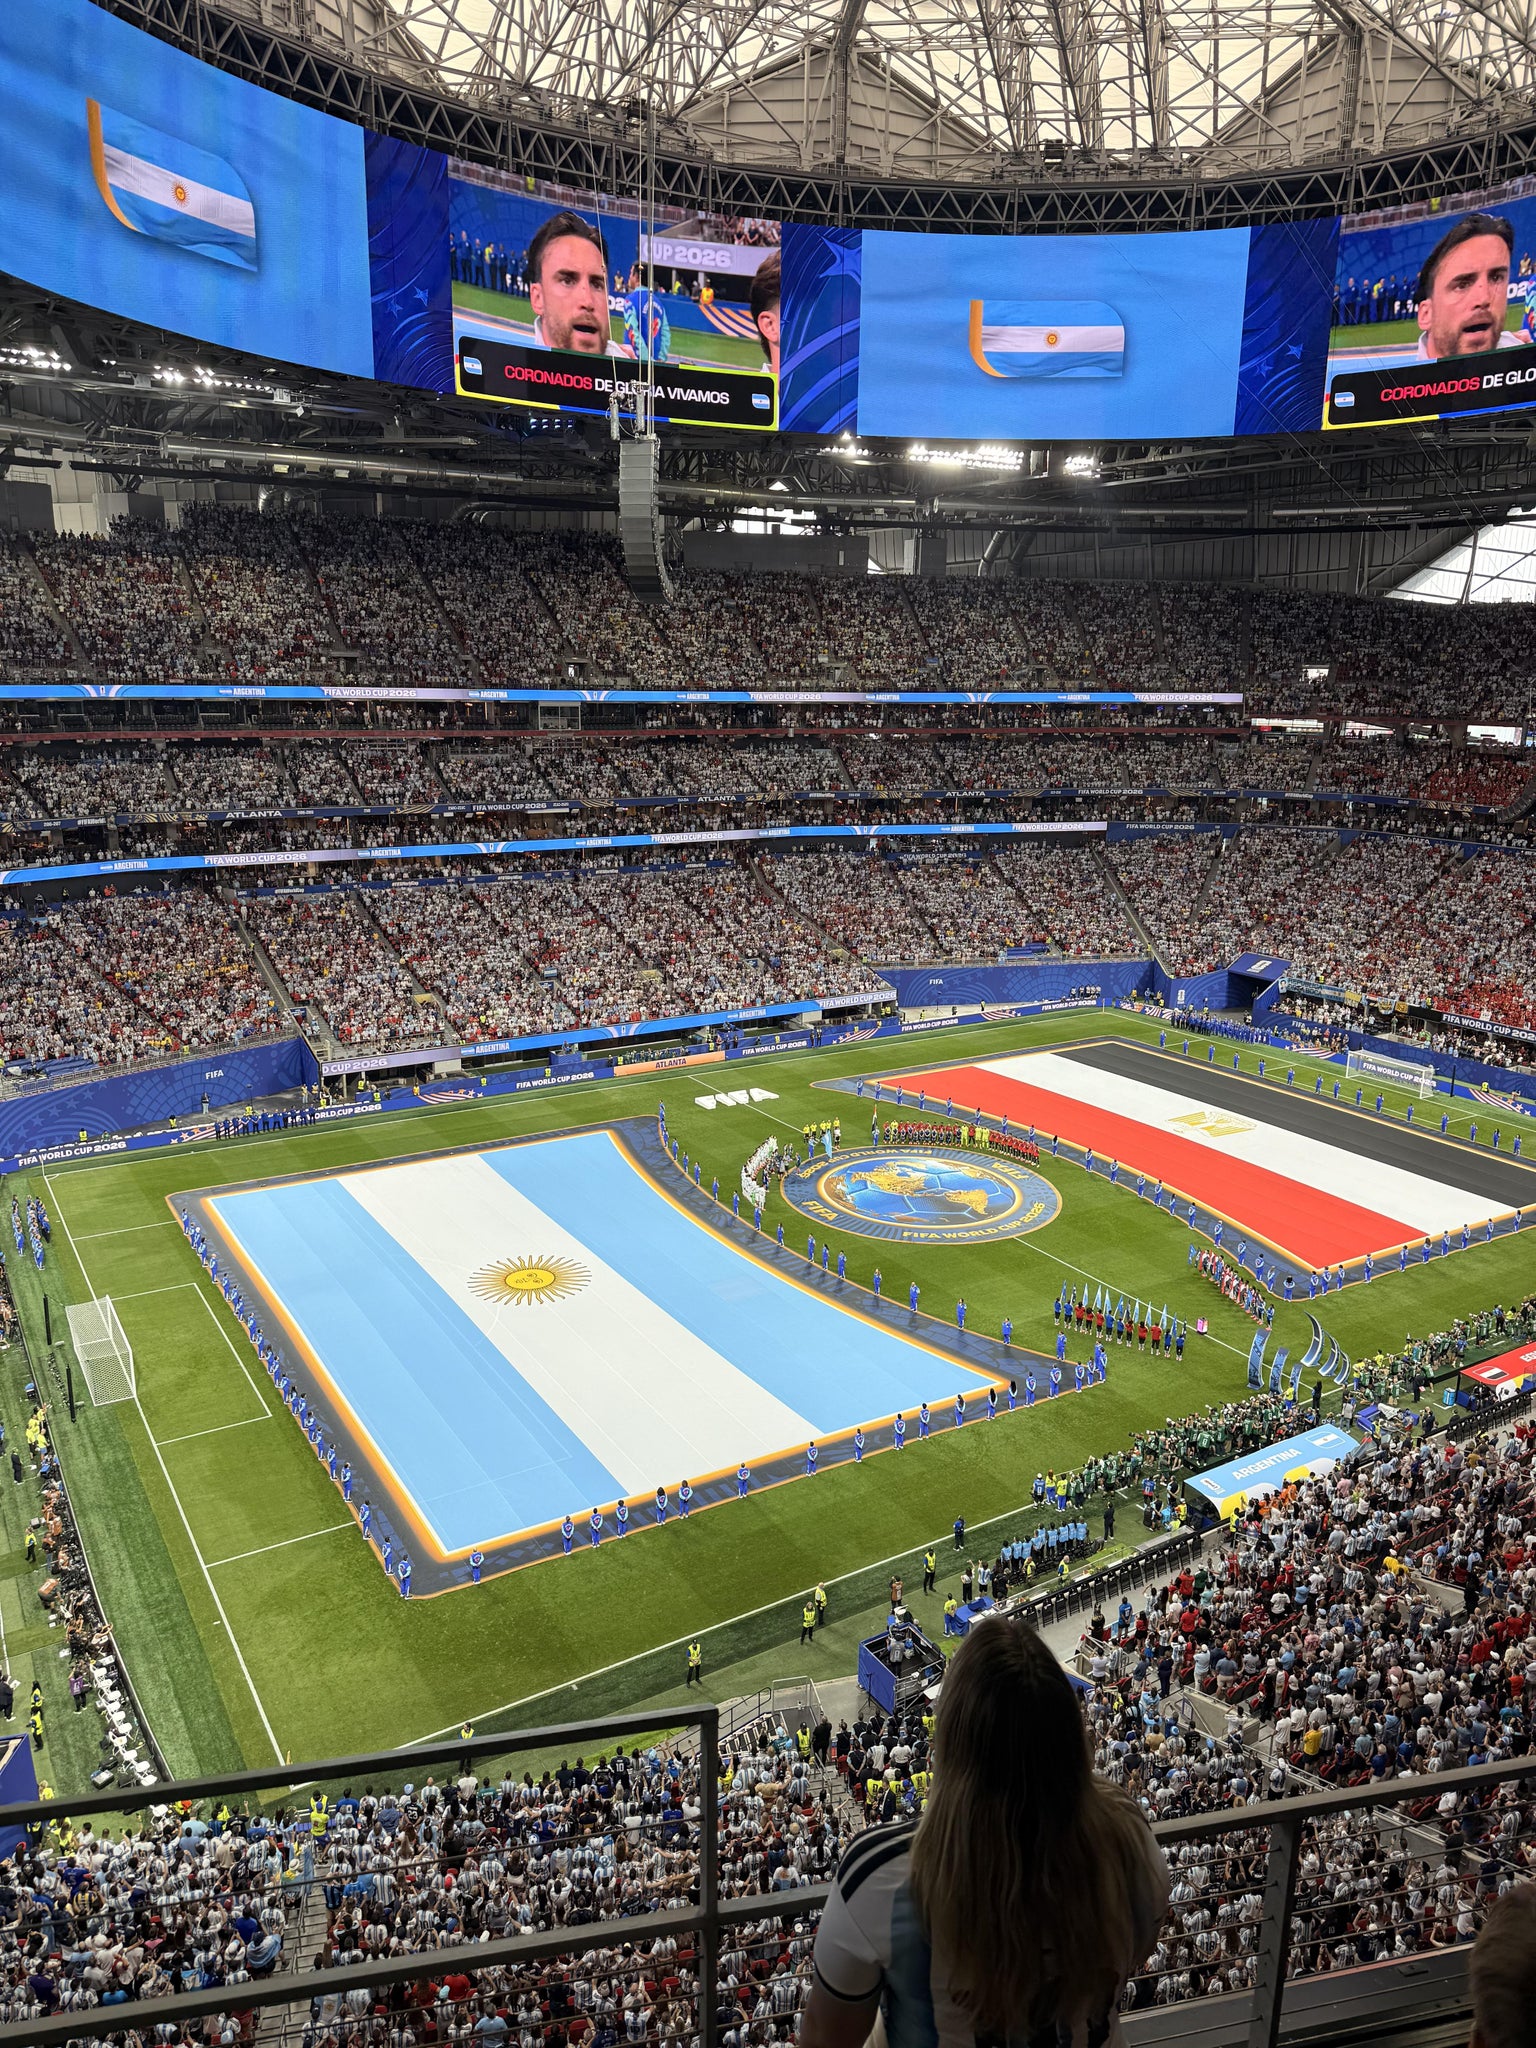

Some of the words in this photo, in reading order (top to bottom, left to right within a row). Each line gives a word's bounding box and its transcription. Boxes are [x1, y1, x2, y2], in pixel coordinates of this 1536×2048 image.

[674, 245, 732, 268] 2026
[504, 365, 593, 390] CORONADOS
[594, 378, 614, 393] DE
[667, 386, 730, 405] VIVAMOS
[1380, 376, 1480, 402] CORONADOS
[1482, 373, 1503, 389] DE
[233, 687, 266, 697] ARGENTINA
[323, 688, 342, 697] FIFA
[342, 689, 371, 697] WORLD
[372, 689, 389, 697] CUP
[389, 689, 417, 697] 2026
[480, 691, 508, 699] ARGENTINA
[225, 810, 283, 819] ATLANTA
[1012, 823, 1026, 831] FIFA
[651, 834, 665, 842] FIFA
[370, 848, 401, 857] ARGENTINA
[113, 860, 149, 870] ARGENTINA
[204, 856, 224, 865] FIFA
[225, 855, 258, 864] WORLD
[258, 854, 276, 863] CUP
[276, 853, 308, 861] 2026
[819, 998, 834, 1008] FIFA
[834, 996, 859, 1006] WORLD
[858, 994, 873, 1003] CUP
[872, 991, 897, 1001] 2026
[1050, 1002, 1068, 1010] WORLD
[901, 1024, 912, 1032] FIFA
[913, 1022, 930, 1031] WORLD
[941, 1018, 959, 1026] 2026
[1291, 1020, 1305, 1028] FIFA
[1442, 1013, 1460, 1024] FIFA
[1461, 1017, 1492, 1031] WORLD
[1493, 1024, 1511, 1035] CUP
[1511, 1029, 1536, 1041] 202
[475, 1041, 510, 1054] ARGENTINA
[755, 1045, 775, 1054] WORLD
[787, 1040, 808, 1048] 2026
[331, 1063, 352, 1072] CUP
[352, 1058, 388, 1070] 2026
[655, 1057, 687, 1069] ATLANTA
[205, 1069, 224, 1080] FIFA
[516, 1080, 531, 1089] FIFA
[532, 1077, 557, 1087] WORLD
[557, 1075, 571, 1083] CUP
[570, 1072, 595, 1081] 2026
[1363, 1062, 1376, 1071] FIFA
[1376, 1066, 1400, 1077] WORLD
[1400, 1072, 1413, 1081] CUP
[1413, 1076, 1437, 1087] 2026
[694, 1087, 780, 1110] FIFA
[337, 1107, 353, 1116] CUP
[354, 1104, 382, 1114] 2026
[18, 1157, 38, 1167] FIFA
[39, 1149, 73, 1161] WORLD
[73, 1146, 93, 1156] CUP
[93, 1141, 127, 1153] 2026
[991, 1161, 1030, 1180] FIFA
[802, 1200, 839, 1221] FIFA
[902, 1231, 942, 1239] FIFA
[941, 1228, 999, 1240] WORLD
[1000, 1220, 1022, 1232] CUP
[1019, 1202, 1046, 1223] 2026
[1231, 1448, 1302, 1480] ARGENTINA
[615, 1762, 625, 1772] 10
[407, 1810, 418, 1820] 23
[484, 1812, 495, 1823] 23
